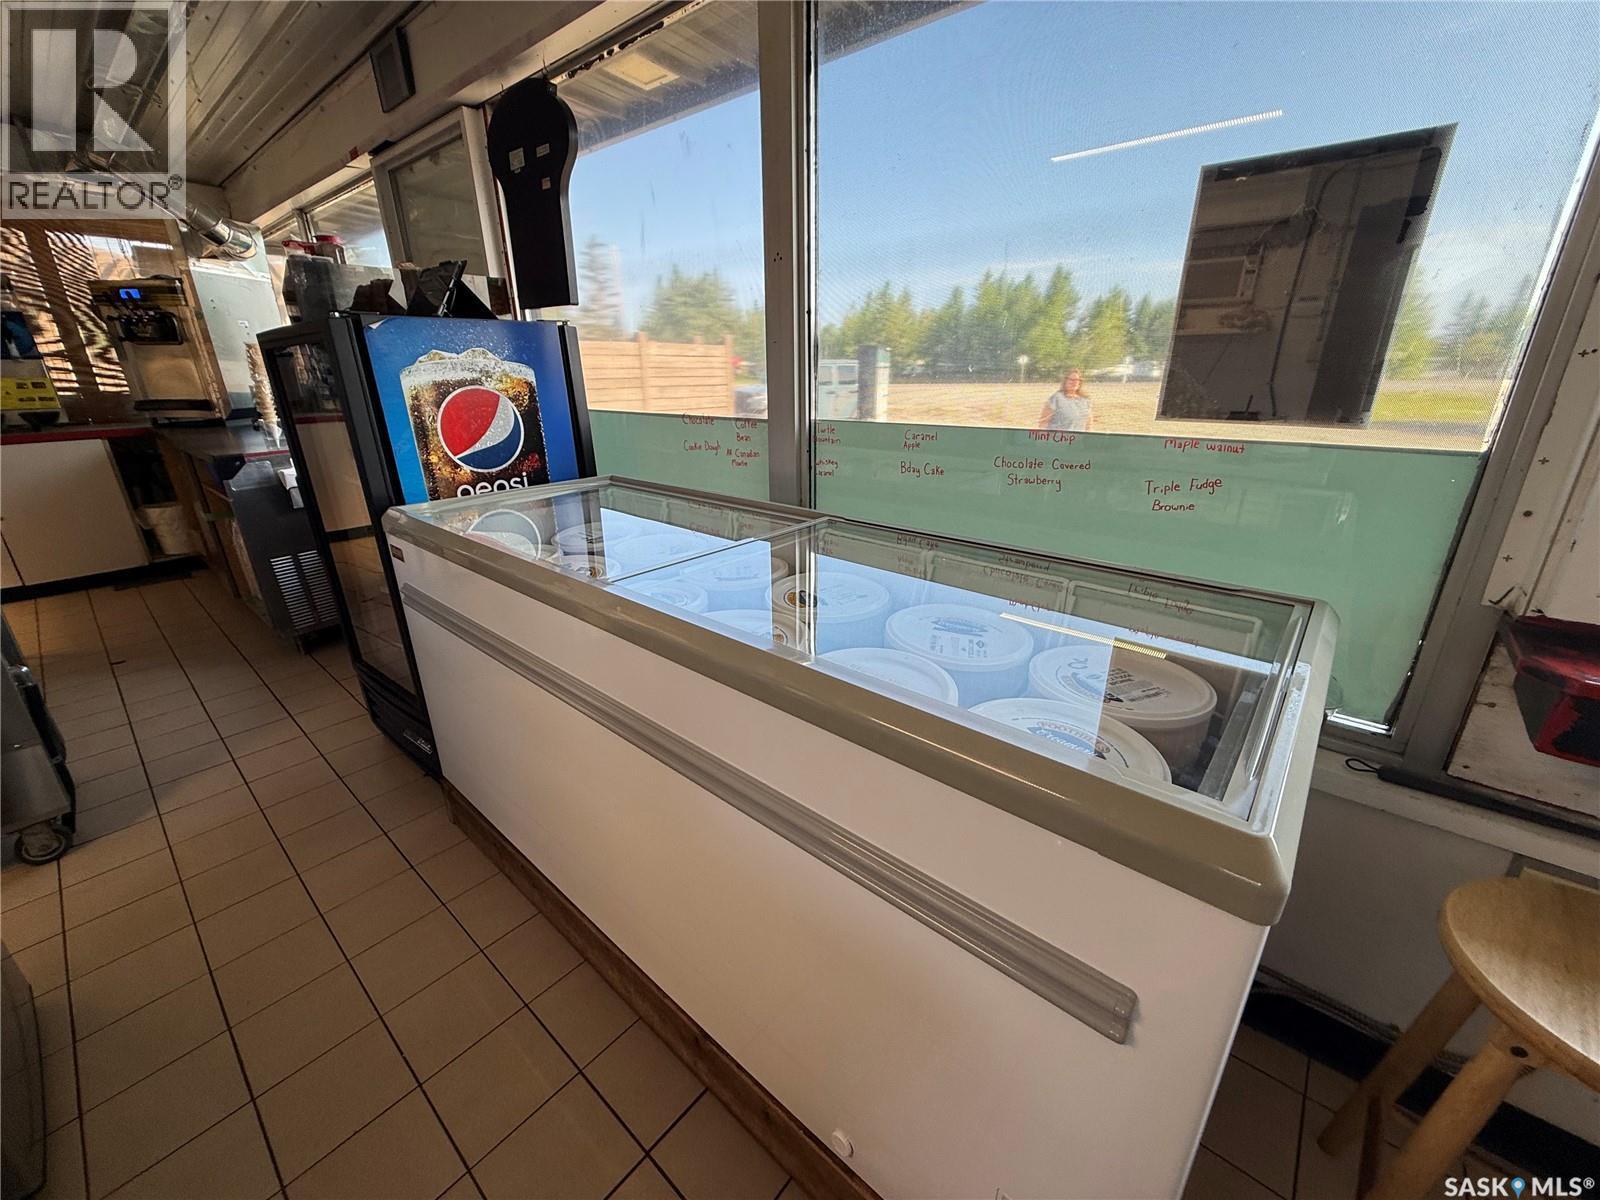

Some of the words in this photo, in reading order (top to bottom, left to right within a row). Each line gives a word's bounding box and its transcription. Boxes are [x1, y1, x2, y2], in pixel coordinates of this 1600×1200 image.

[816, 423, 836, 435] Turtle
[904, 429, 938, 441] Caramel
[814, 436, 841, 445] ountain
[1028, 430, 1051, 441] Mint
[1053, 430, 1076, 445] Chip
[903, 441, 921, 452] Apple
[1164, 439, 1201, 453] Maple
[900, 460, 921, 478] Bday
[923, 462, 945, 476] Cake
[993, 456, 1044, 469] Chocolate
[1051, 458, 1091, 470] Covered
[1007, 473, 1062, 493] Strawberry
[1144, 480, 1181, 496] Triple
[1189, 478, 1224, 496] Fudge
[1151, 498, 1196, 512] Brownie
